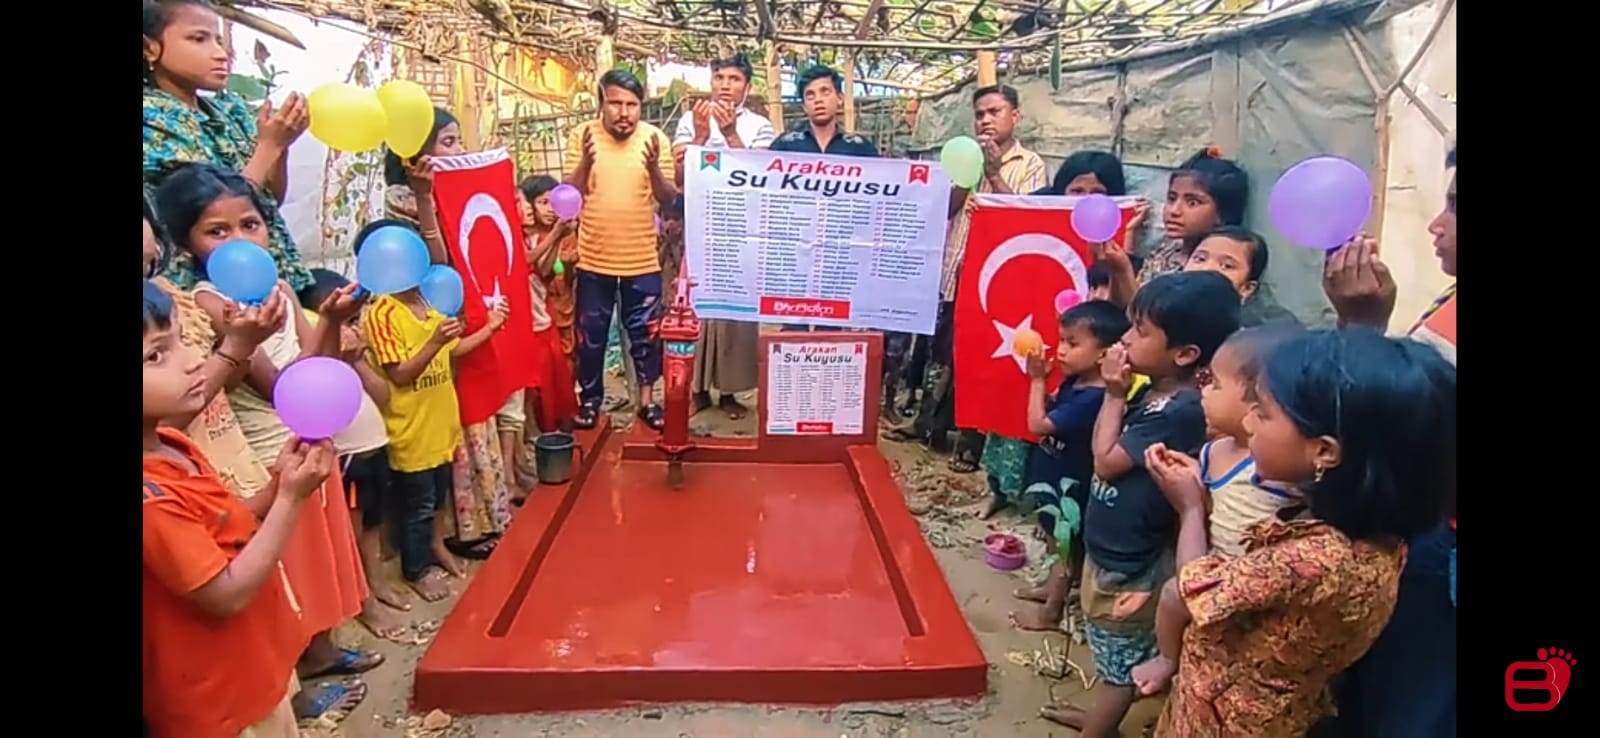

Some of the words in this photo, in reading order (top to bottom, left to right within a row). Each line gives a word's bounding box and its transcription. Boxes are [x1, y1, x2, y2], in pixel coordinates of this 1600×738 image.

[766, 158, 863, 178] Arakan
[727, 170, 768, 188] Su
[780, 173, 901, 197] Kuyusu
[799, 345, 838, 353] Arakan
[783, 353, 801, 363] Su
[804, 353, 852, 365] Kuyusu
